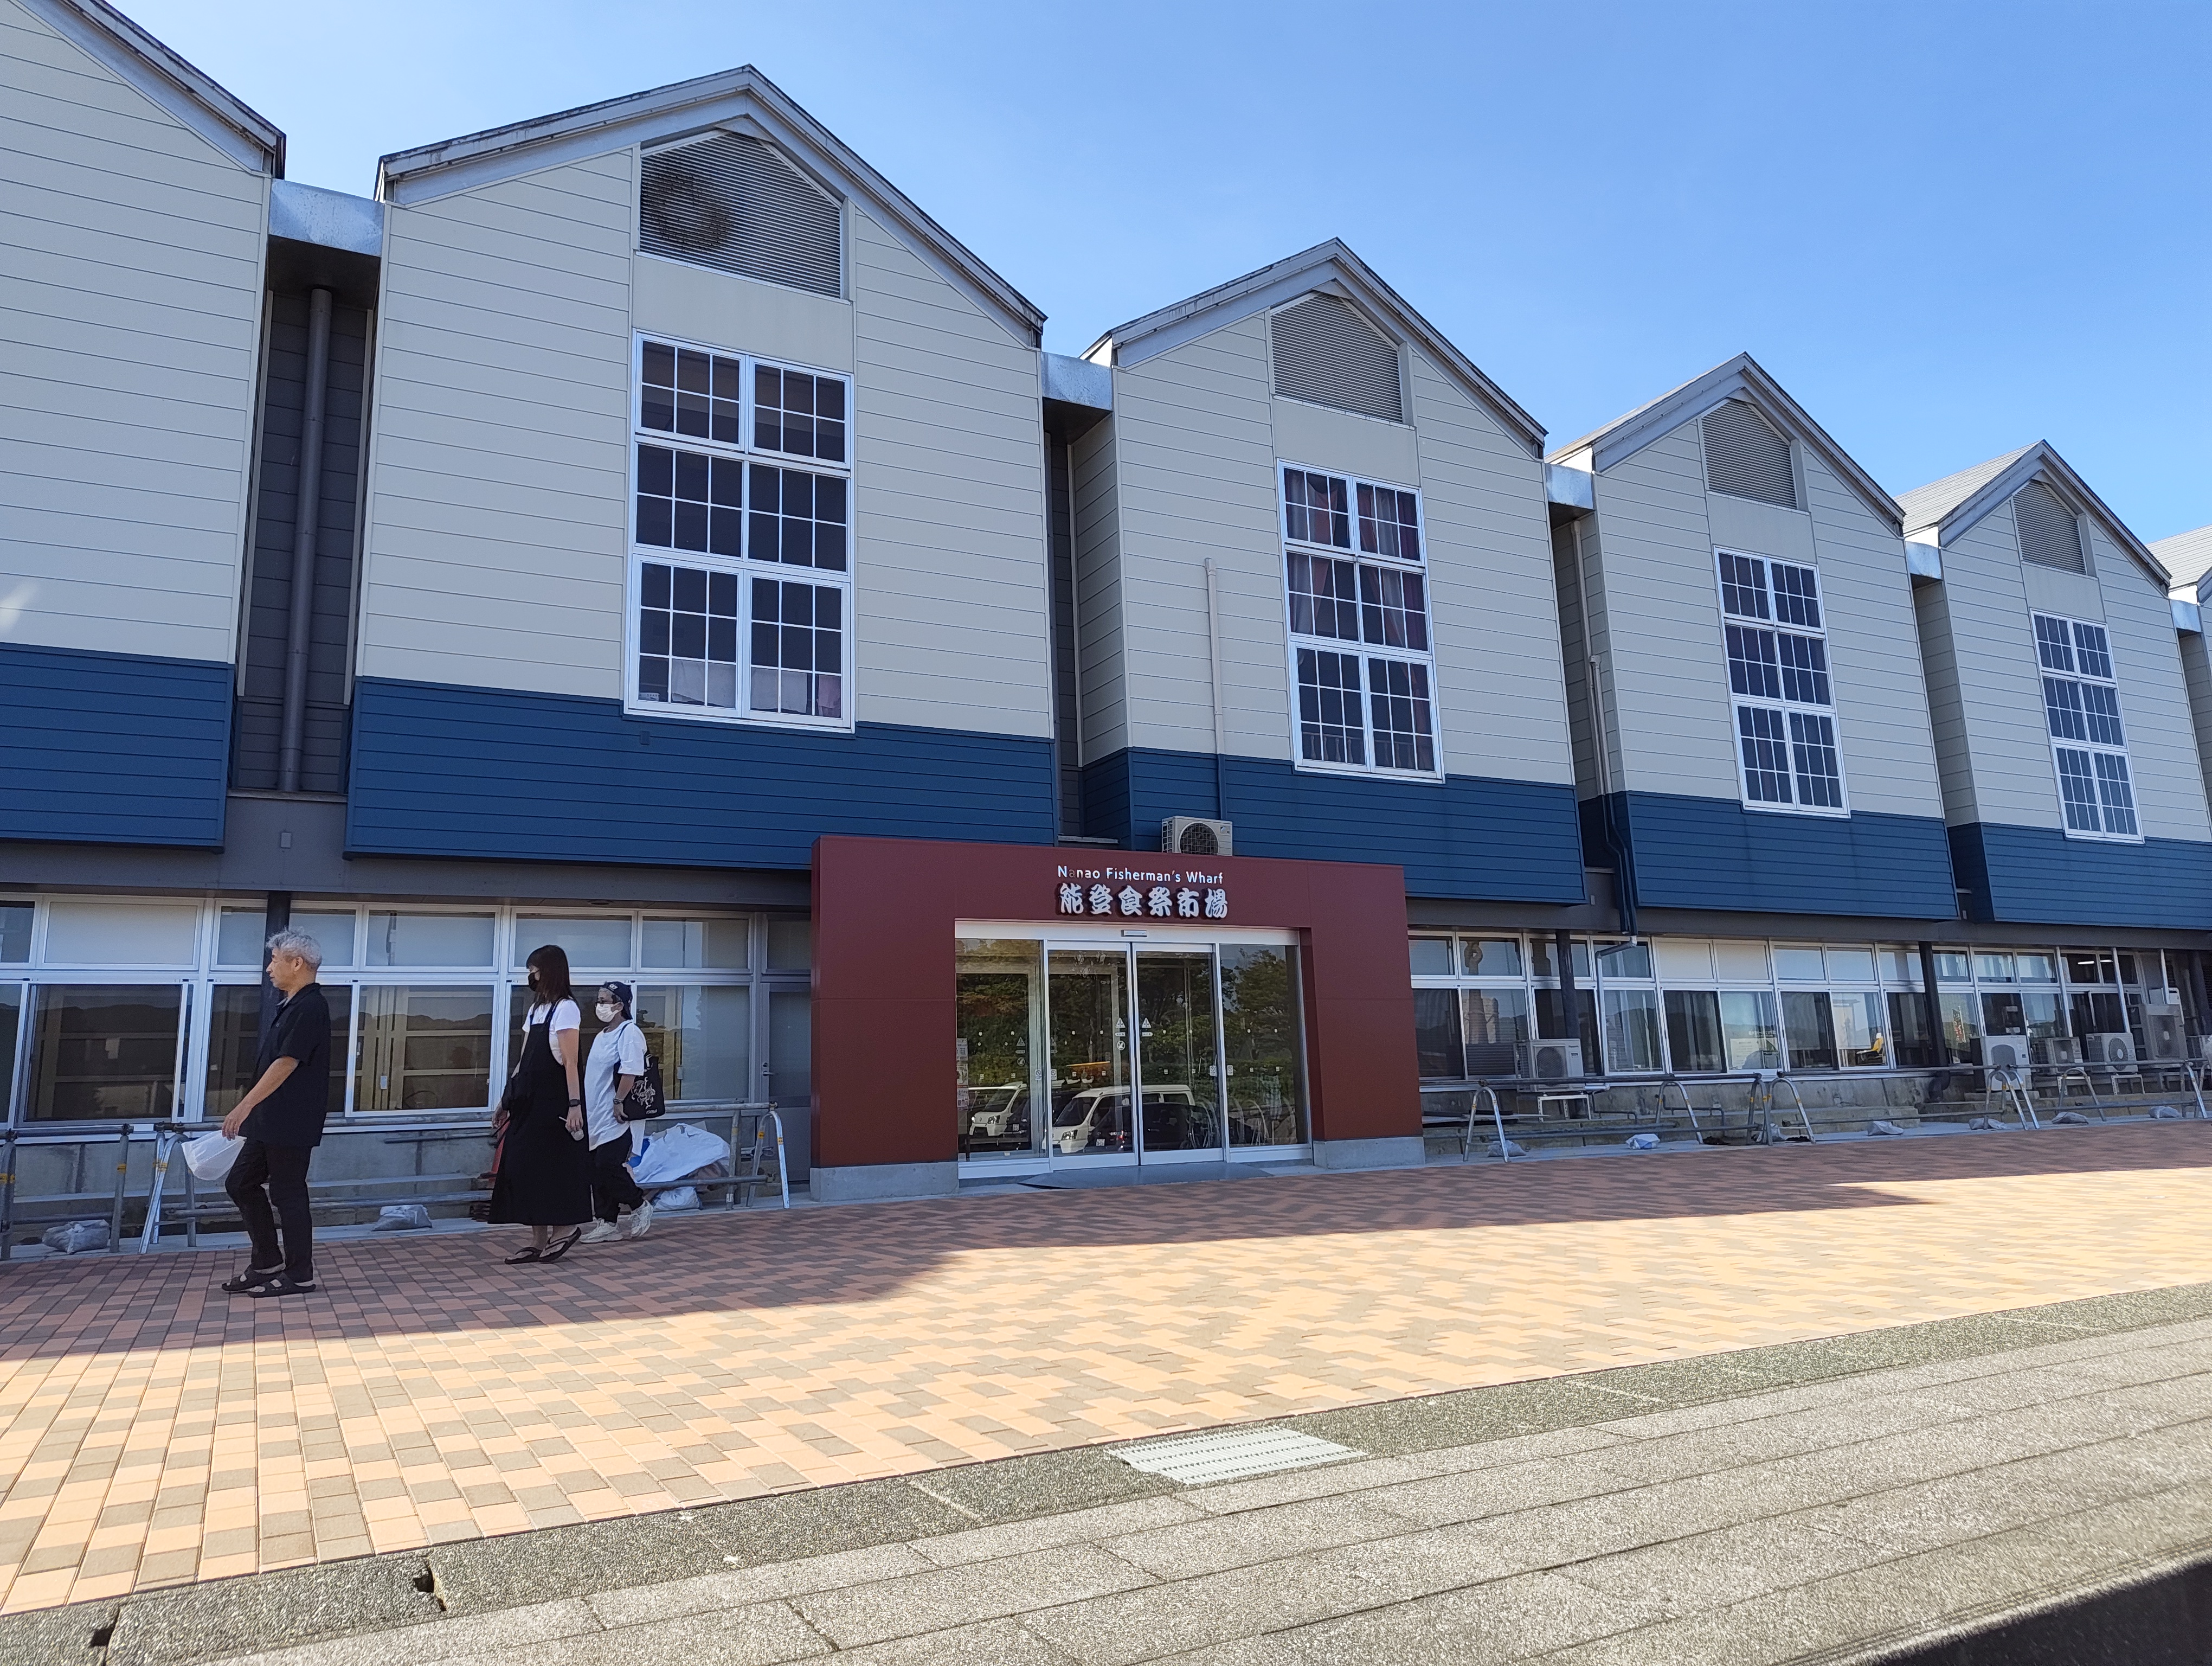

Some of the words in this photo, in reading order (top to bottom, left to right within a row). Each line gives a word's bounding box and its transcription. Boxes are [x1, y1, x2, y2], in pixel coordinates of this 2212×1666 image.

[1058, 865, 1100, 879] Nanao
[1106, 867, 1181, 882] Fisherman's
[1186, 871, 1223, 885] Wharf
[1059, 882, 1227, 918] 能登食祭市場
